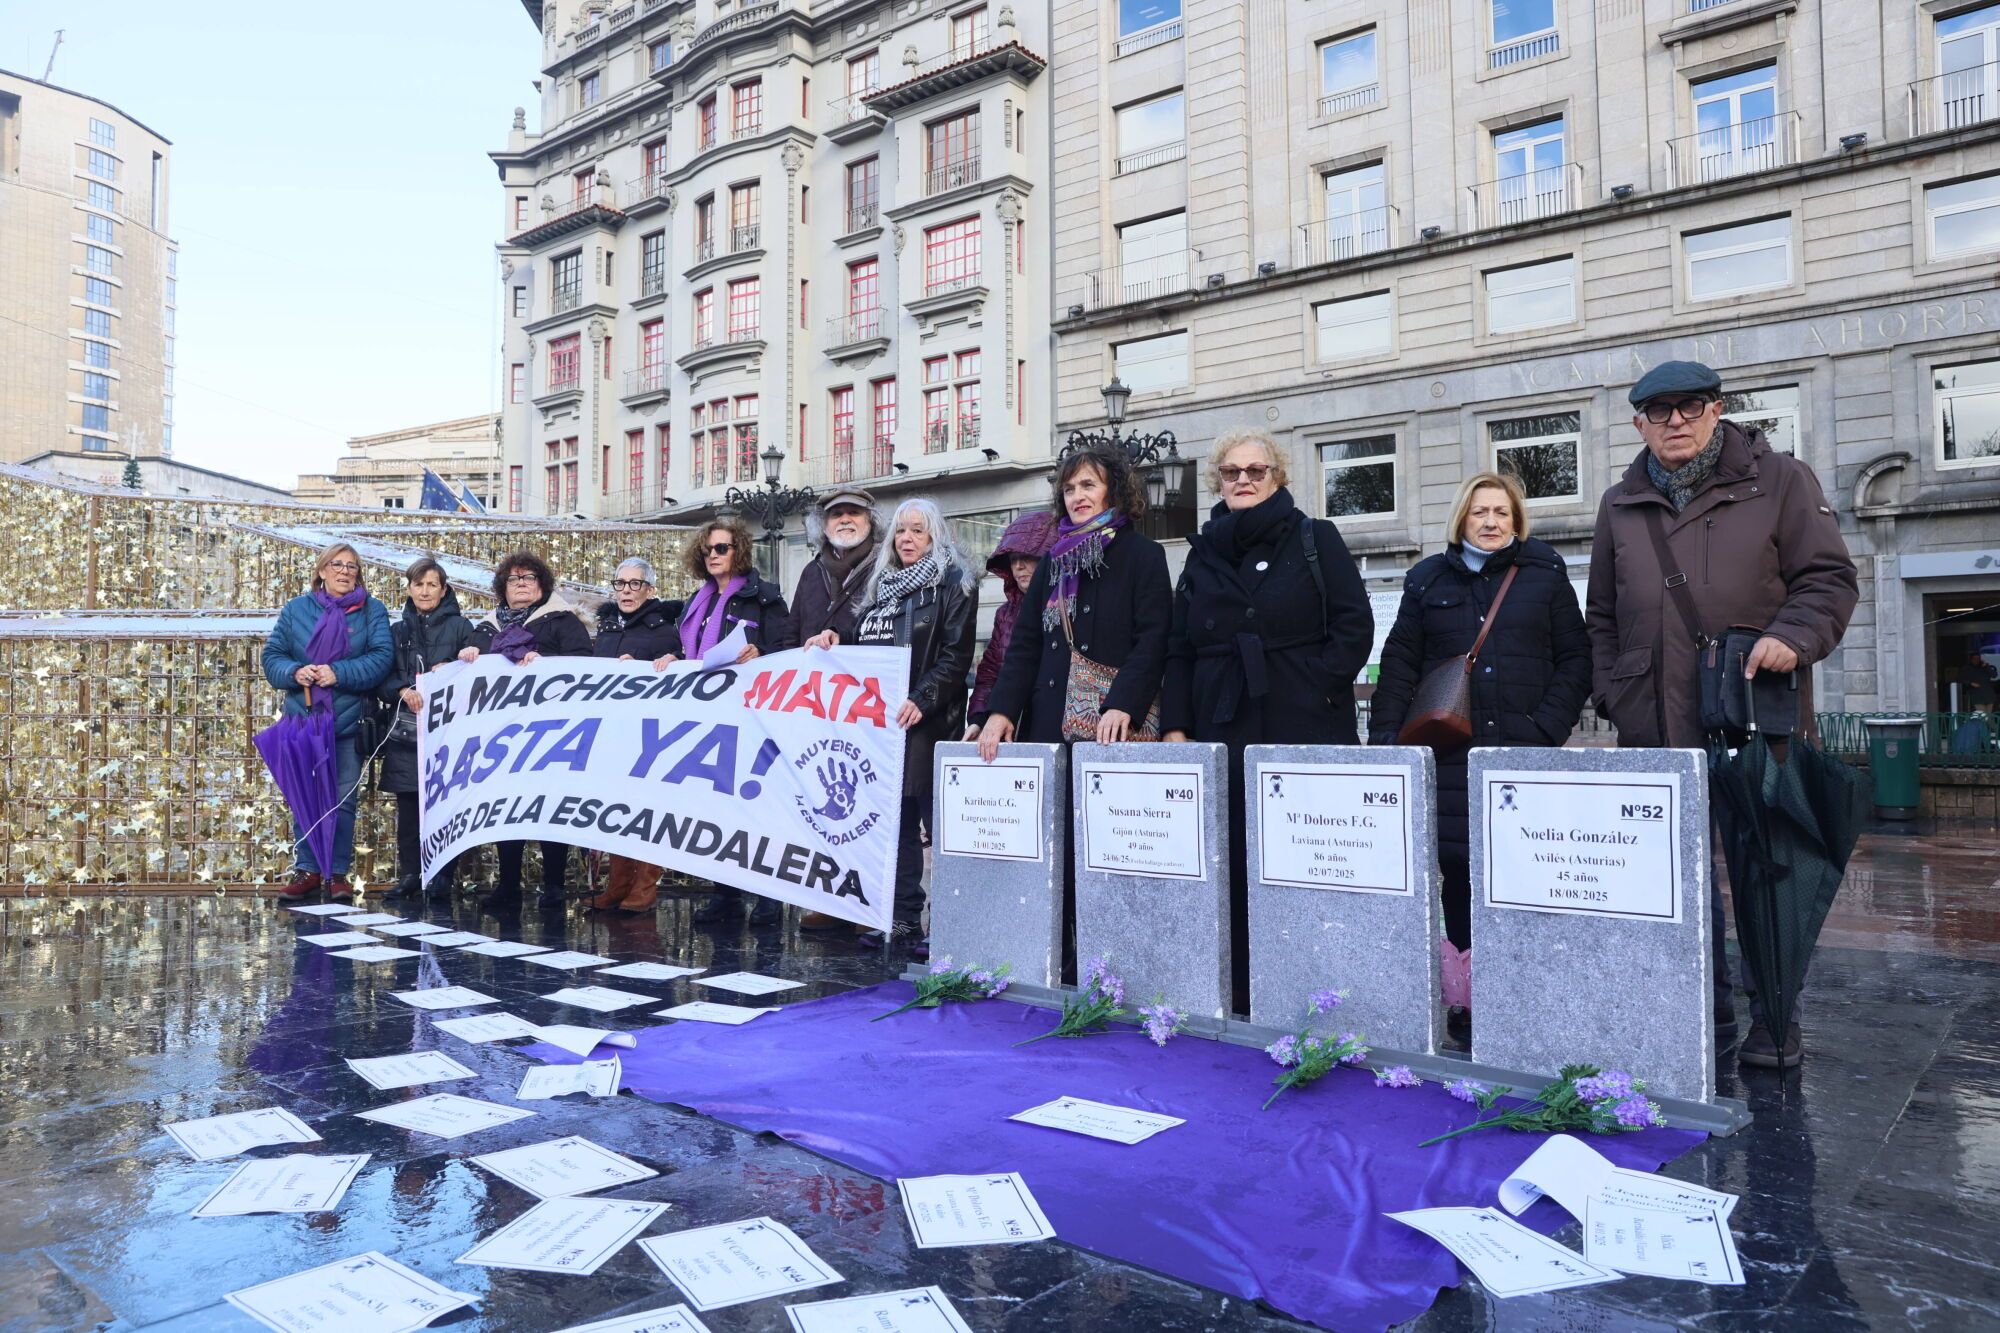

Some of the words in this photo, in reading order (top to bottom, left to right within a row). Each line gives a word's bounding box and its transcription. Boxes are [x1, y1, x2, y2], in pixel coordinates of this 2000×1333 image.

[1530, 344, 1646, 387] CAJA
[1695, 334, 1746, 364] DE
[428, 684, 456, 733] EL
[466, 669, 738, 716] MACHISMO
[744, 669, 887, 728] MATA
[628, 718, 781, 800] YA!
[859, 758, 877, 784] DE
[1028, 780, 1035, 790] 6
[1108, 805, 1141, 817] Susana
[1143, 806, 1171, 819] Sierra
[1304, 813, 1348, 827] Dolores
[1351, 815, 1377, 828] F.G.
[977, 827, 986, 837] 39
[987, 828, 1000, 837] años
[1112, 826, 1133, 838] Gijón
[1134, 828, 1169, 840] (Asturias)
[1520, 827, 1564, 842] Noelia
[1569, 828, 1638, 845] González
[1128, 842, 1137, 850] 49
[1139, 843, 1154, 852] años
[1292, 835, 1325, 846] Laviana
[1327, 837, 1373, 850] (Asturias)
[469, 798, 508, 833] DE
[504, 795, 546, 825] LA
[549, 796, 870, 907] ESCANDALERA
[1314, 852, 1325, 861] 86
[1327, 853, 1348, 863] años
[1531, 853, 1565, 864] Avilés
[1569, 854, 1626, 868] (Asturias)
[1308, 867, 1355, 879] 02/07/2025
[1556, 871, 1570, 881] 45
[1573, 872, 1599, 883] años
[1549, 888, 1608, 901] 18/08/2025
